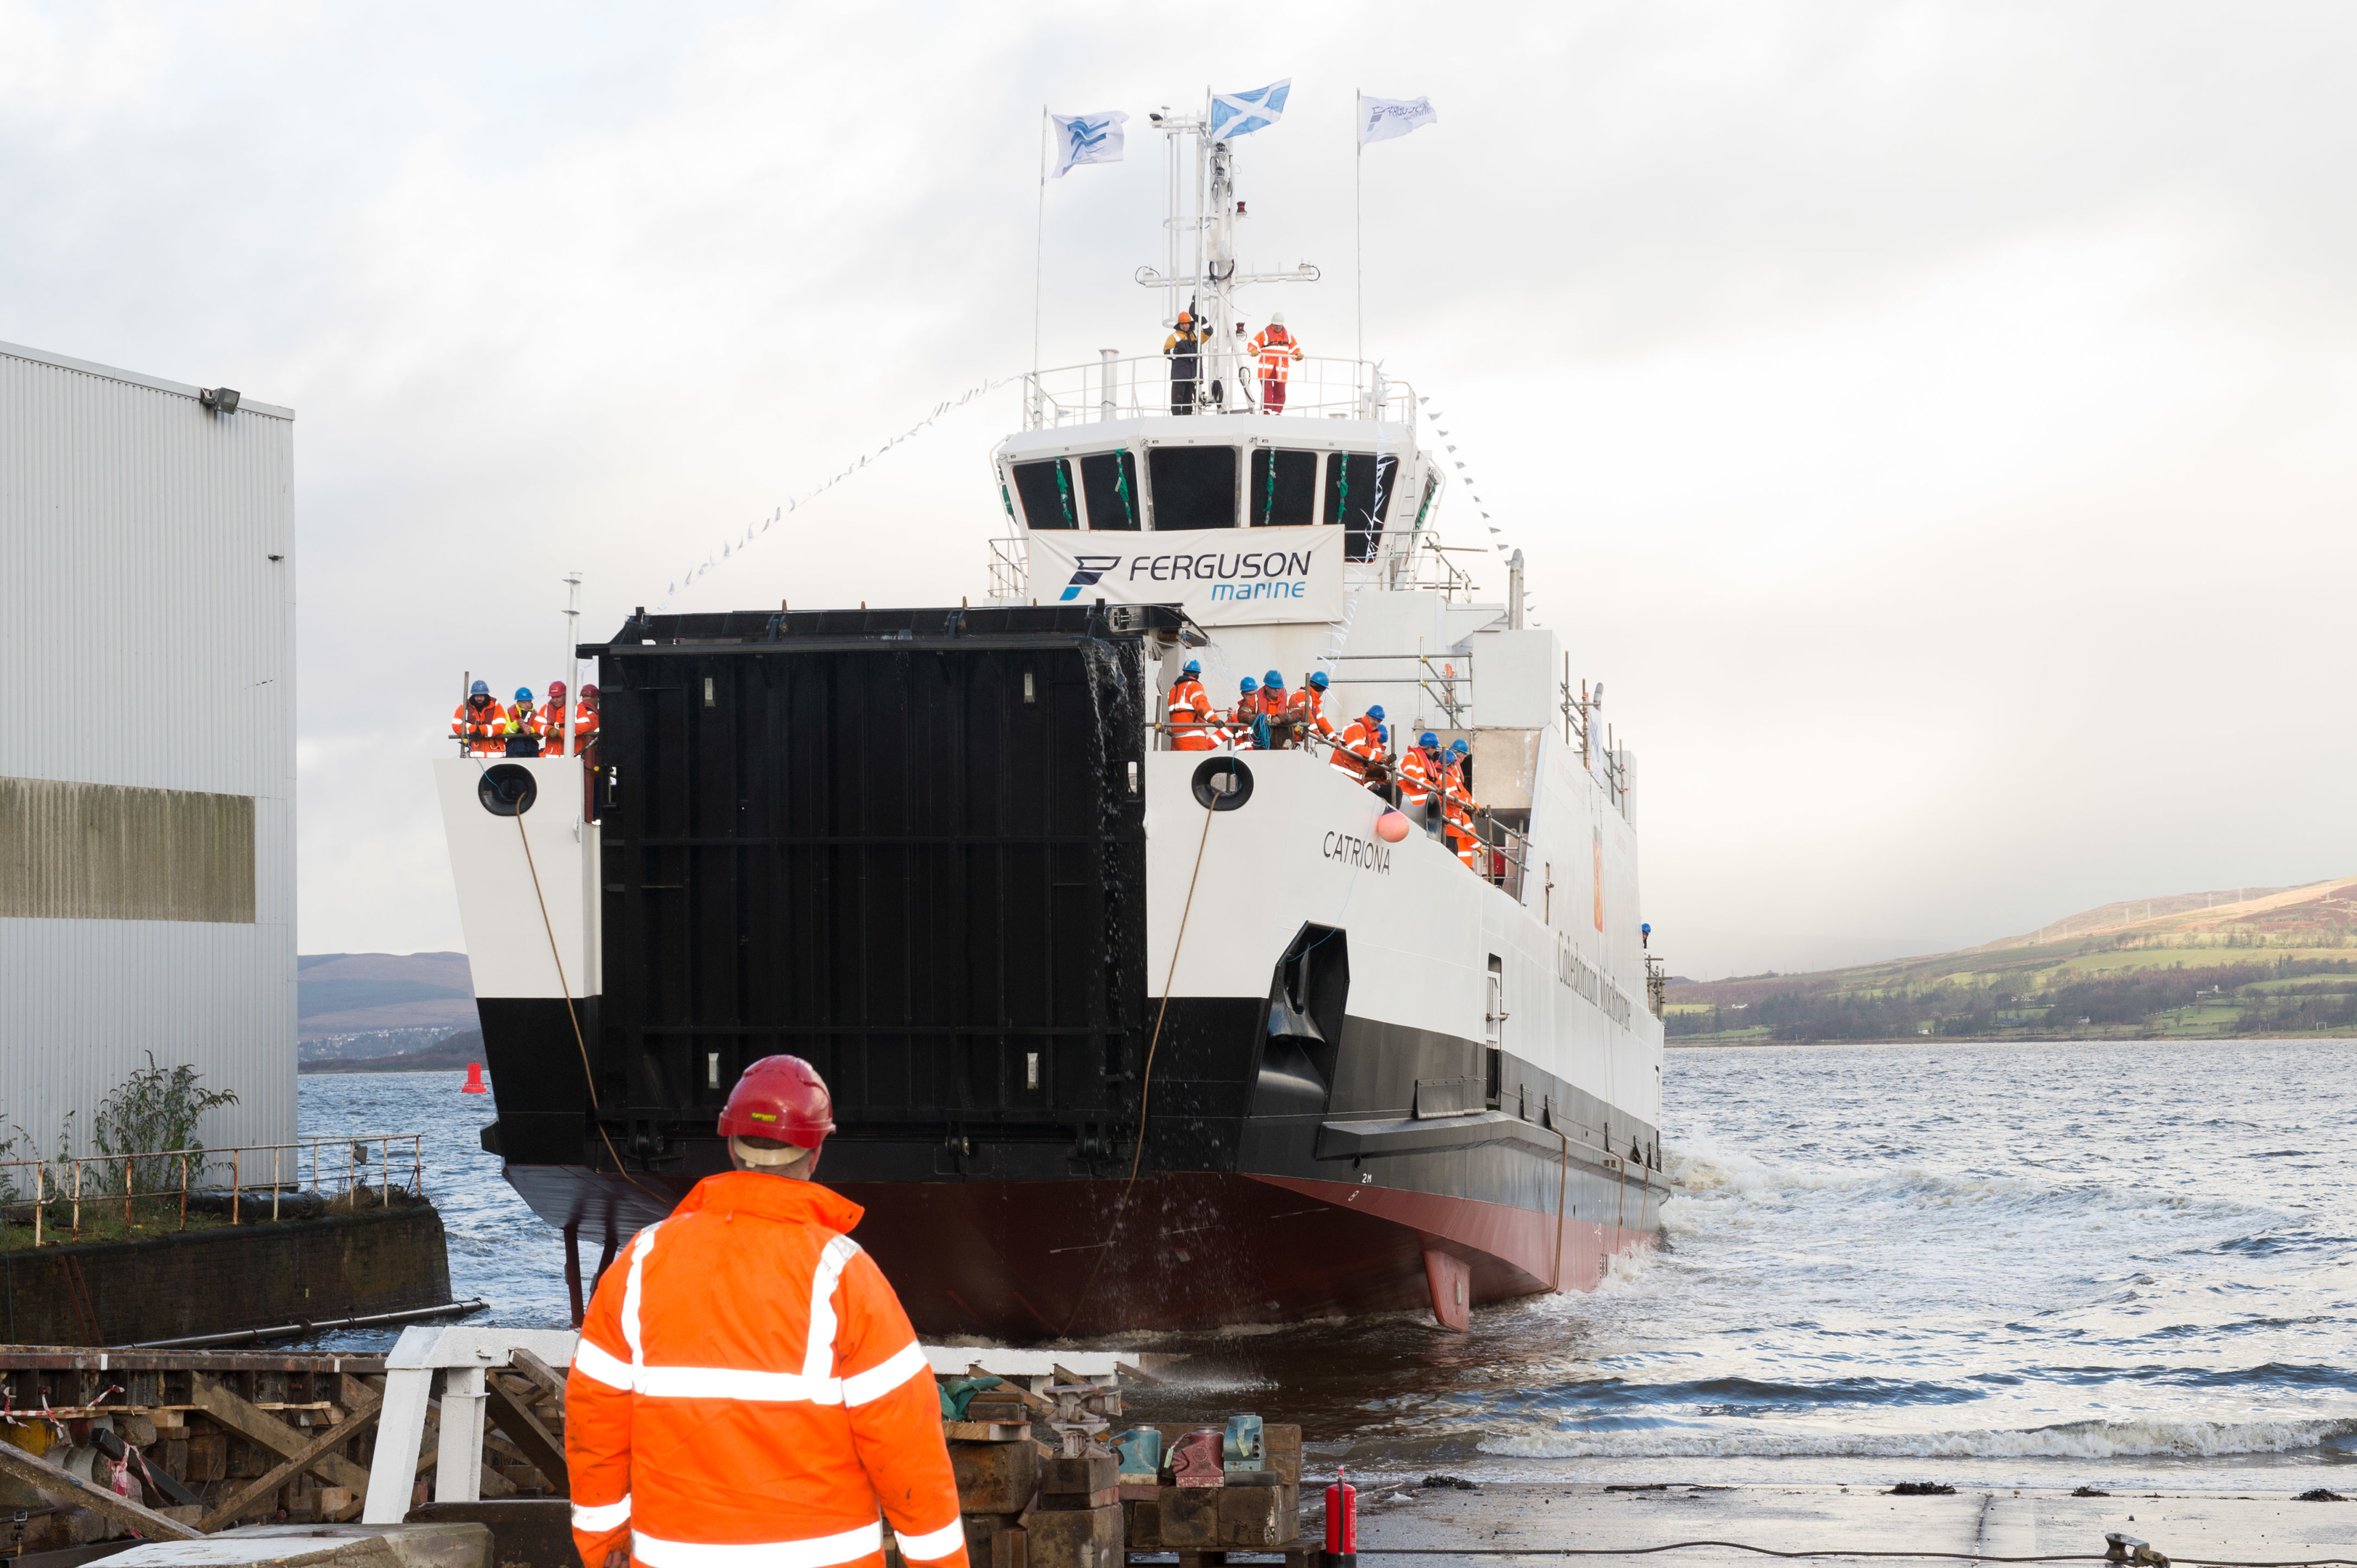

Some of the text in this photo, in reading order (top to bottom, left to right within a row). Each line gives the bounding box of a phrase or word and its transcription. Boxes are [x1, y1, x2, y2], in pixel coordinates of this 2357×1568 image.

[1129, 552, 1311, 581] FERGUSON
[1211, 581, 1306, 601] marine
[1323, 830, 1390, 875] CATRIONA
[1558, 931, 1631, 1037] Caledonian MacBrayne
[1361, 1172, 1372, 1183] 2M
